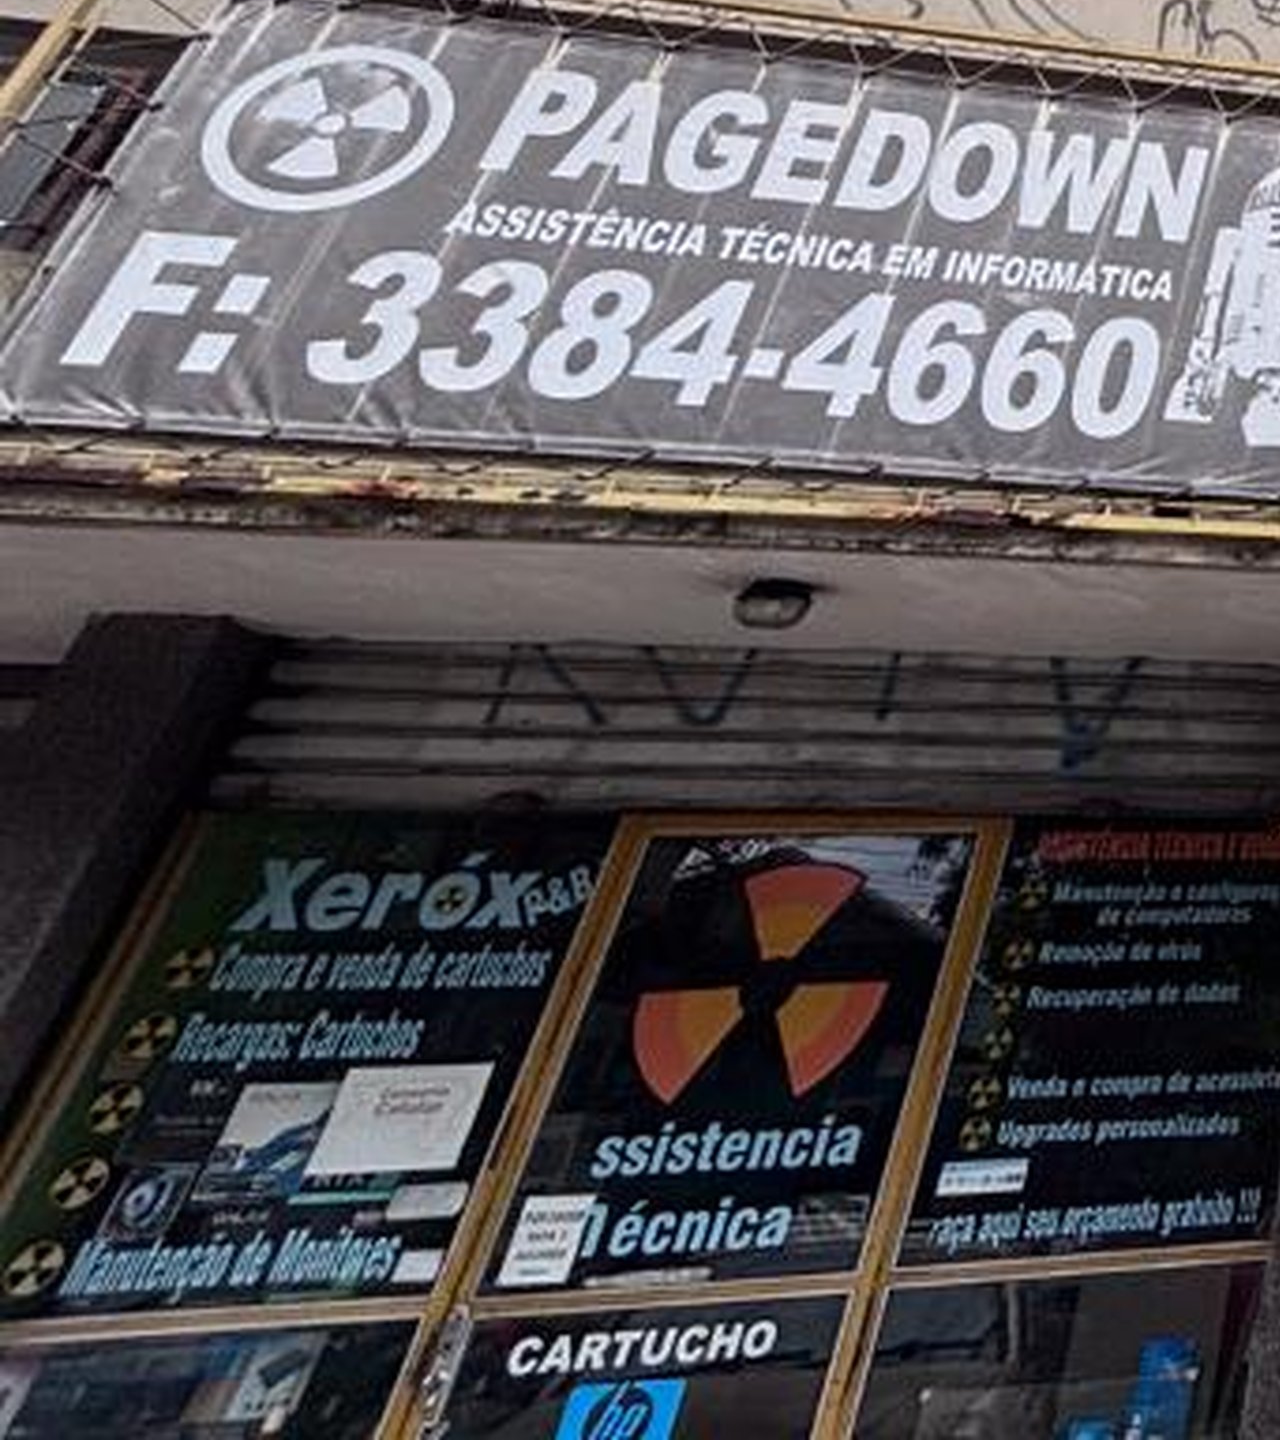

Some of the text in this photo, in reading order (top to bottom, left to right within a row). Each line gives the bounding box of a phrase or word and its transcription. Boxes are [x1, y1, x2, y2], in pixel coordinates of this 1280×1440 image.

[478, 68, 1210, 243] PAGEDOWN
[445, 202, 1175, 302] ASSISTÊNCIA TÉCNICA EM INFORMÁTICA
[60, 231, 1160, 439] F: 3384-4660
[229, 852, 541, 931] Xeróx
[210, 939, 552, 1002] Compra e venda de cartuchos
[300, 1012, 424, 1059] Cartuchos
[1007, 1073, 1067, 1100] Venda
[1090, 1075, 1161, 1101] compra
[229, 1231, 273, 1285] de
[507, 1321, 779, 1376] CARTUCHO
